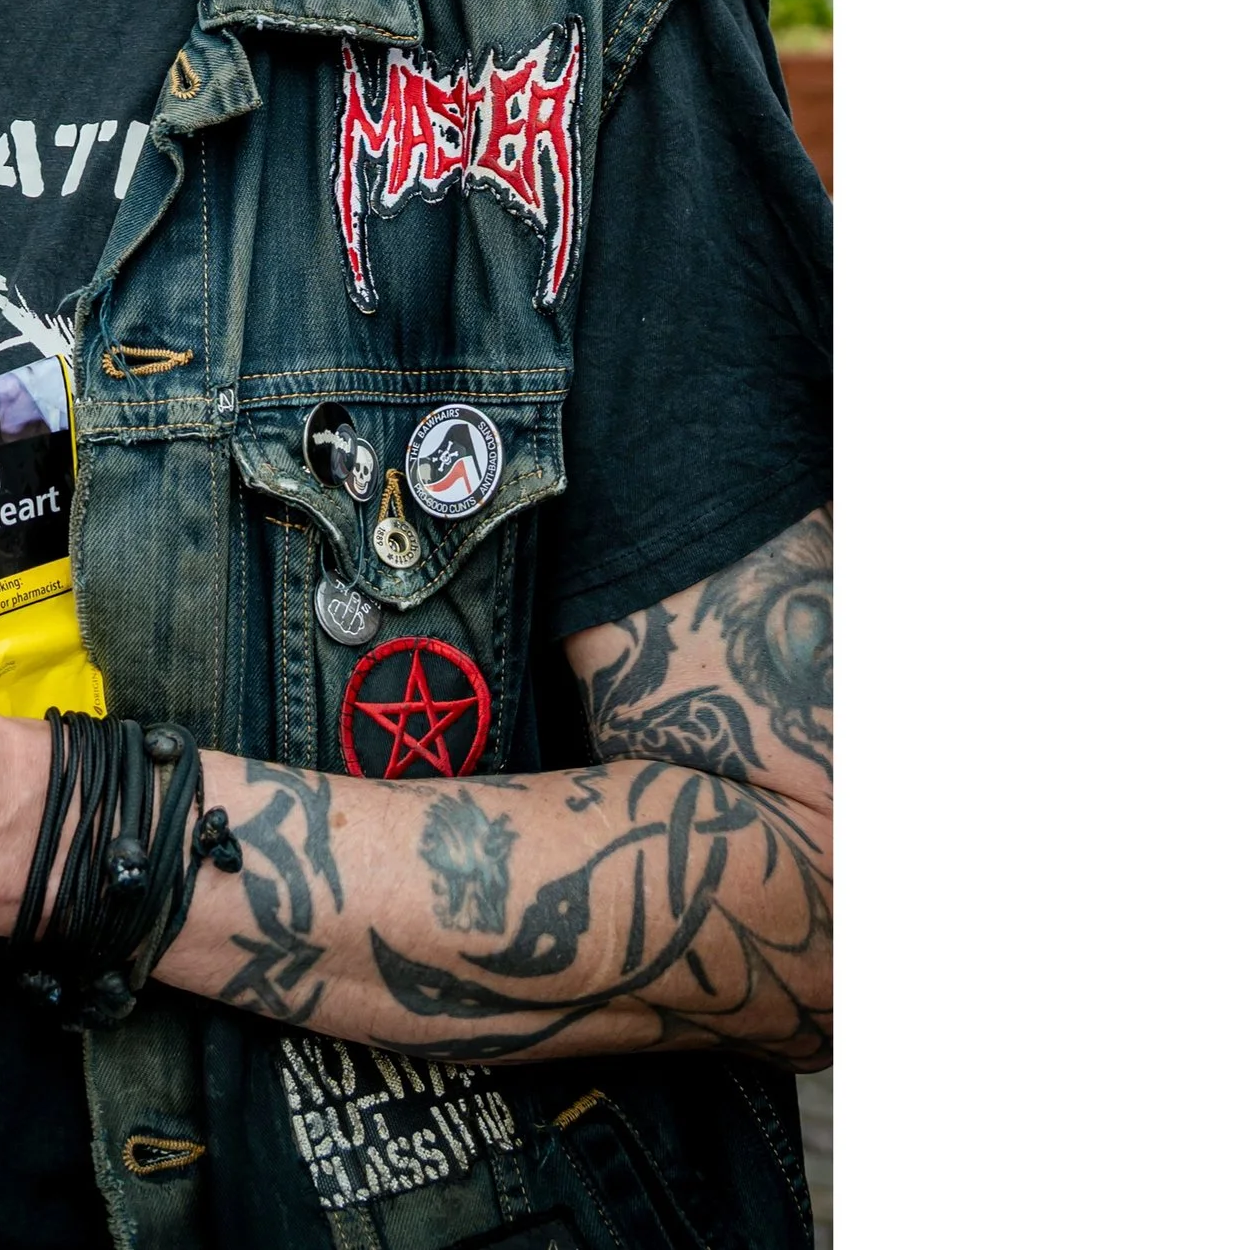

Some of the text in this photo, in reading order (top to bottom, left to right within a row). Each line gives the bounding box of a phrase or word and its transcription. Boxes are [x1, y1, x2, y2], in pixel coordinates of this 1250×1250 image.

[409, 408, 460, 462] THE BAWHAIRS
[477, 421, 498, 495] ANTI-BAD CUNTS
[449, 496, 477, 514] CUNTS
[375, 527, 386, 547] 1889
[0, 599, 10, 609] or
[11, 579, 65, 607] pharmacist.
